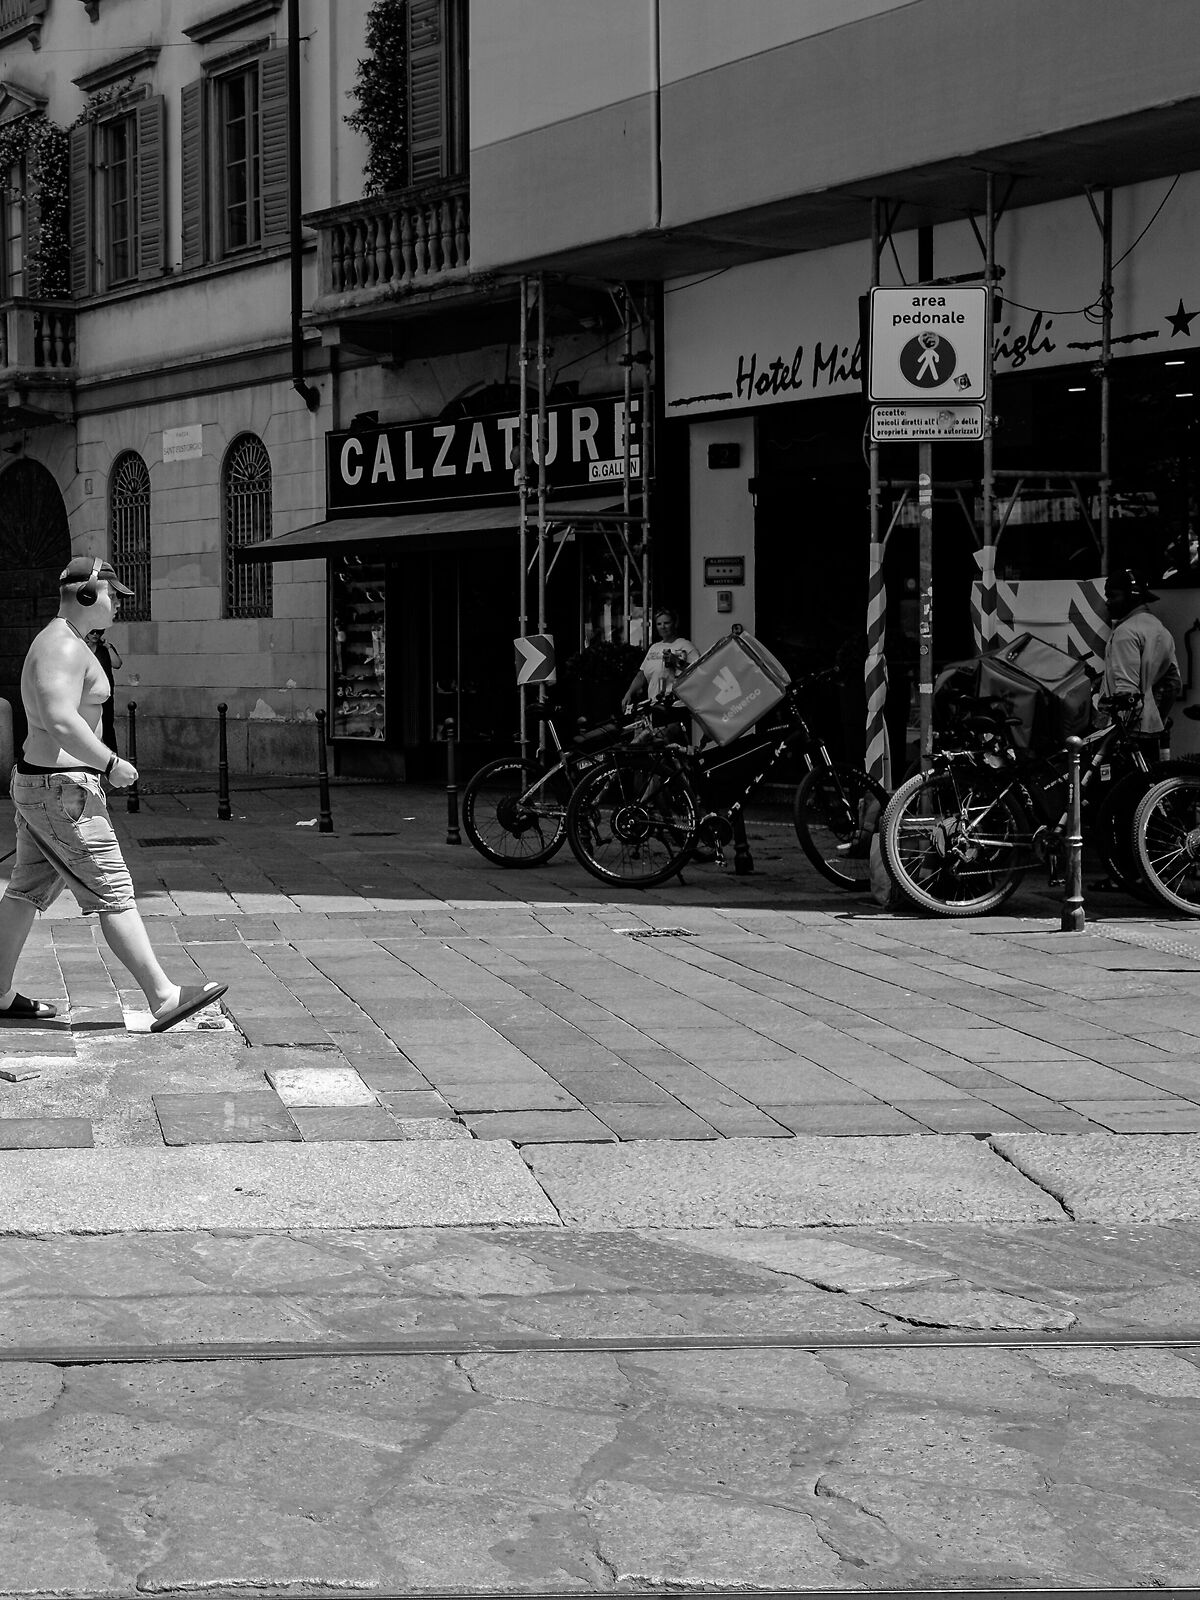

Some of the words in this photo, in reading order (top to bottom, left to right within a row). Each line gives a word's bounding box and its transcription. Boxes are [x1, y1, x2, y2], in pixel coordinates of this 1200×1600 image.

[912, 296, 946, 307] area
[892, 311, 965, 327] pedonale
[736, 345, 804, 400] Hotel
[812, 337, 863, 388] Mil
[993, 311, 1056, 368] igli
[912, 428, 936, 437] private
[340, 400, 639, 486] CALZATURE
[591, 460, 637, 478] G.GALLN
